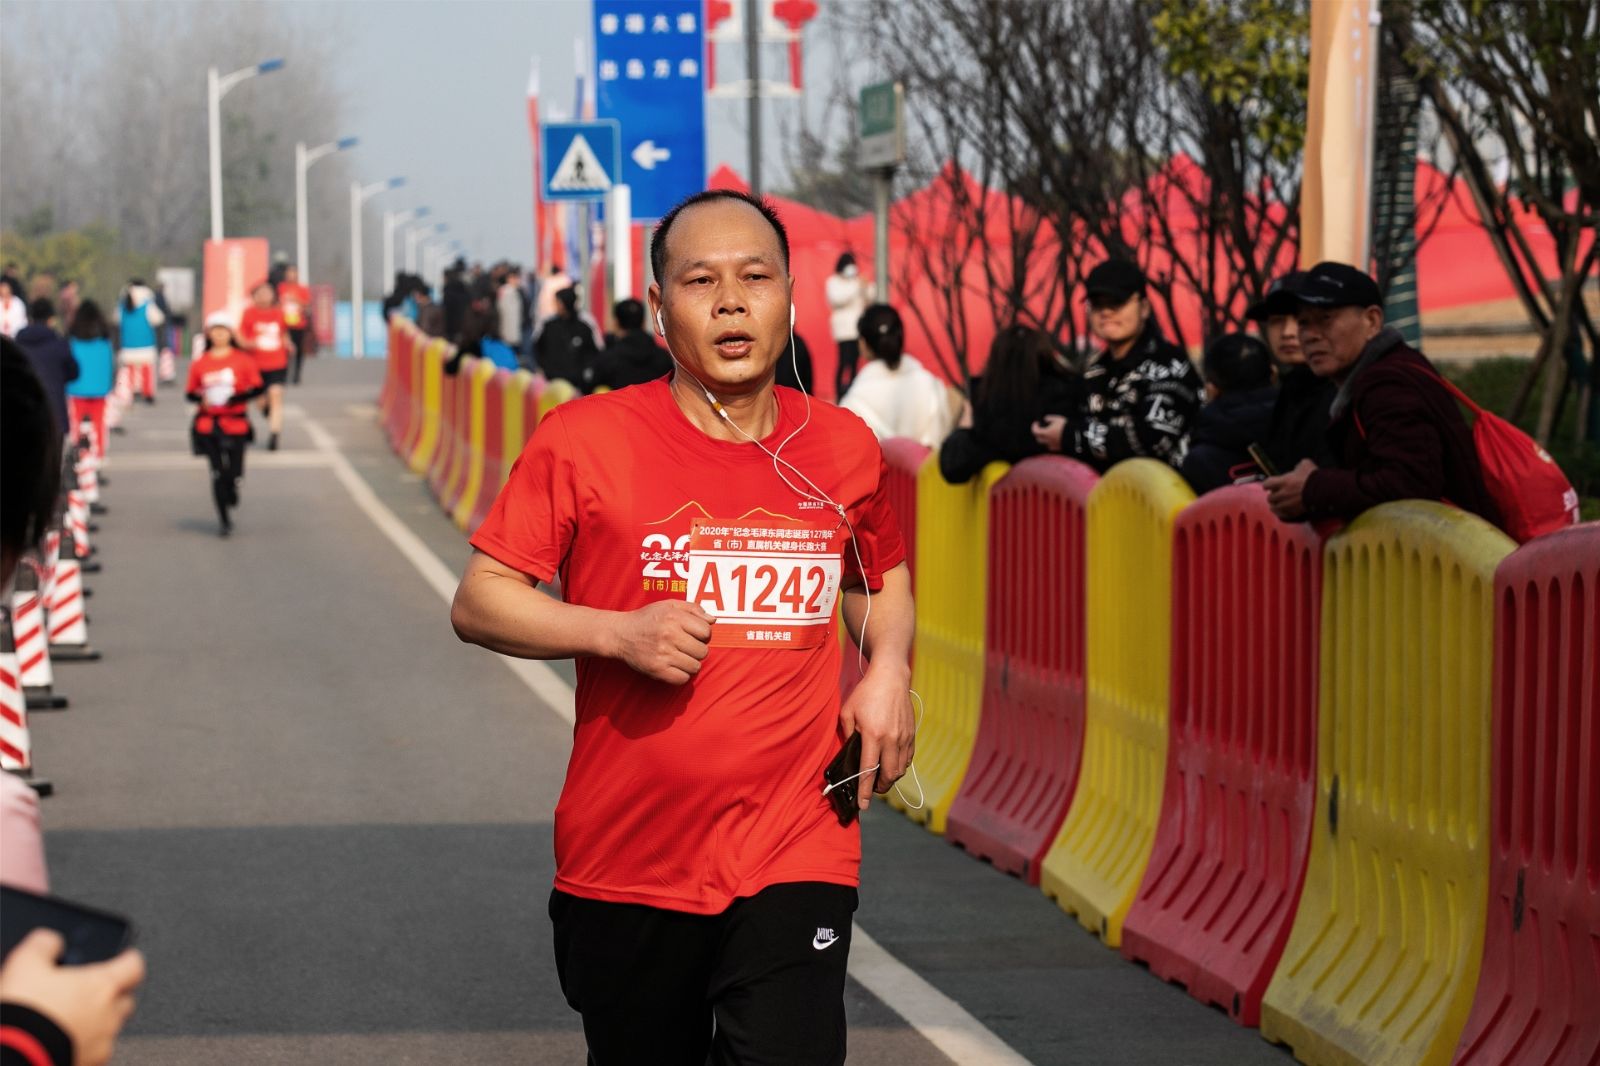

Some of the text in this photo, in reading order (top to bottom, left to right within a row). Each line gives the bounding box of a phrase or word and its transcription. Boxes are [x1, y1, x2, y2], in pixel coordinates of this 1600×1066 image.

[694, 562, 825, 613] A1242
[746, 630, 792, 641] 省直机关组
[817, 927, 835, 940] NIKE
